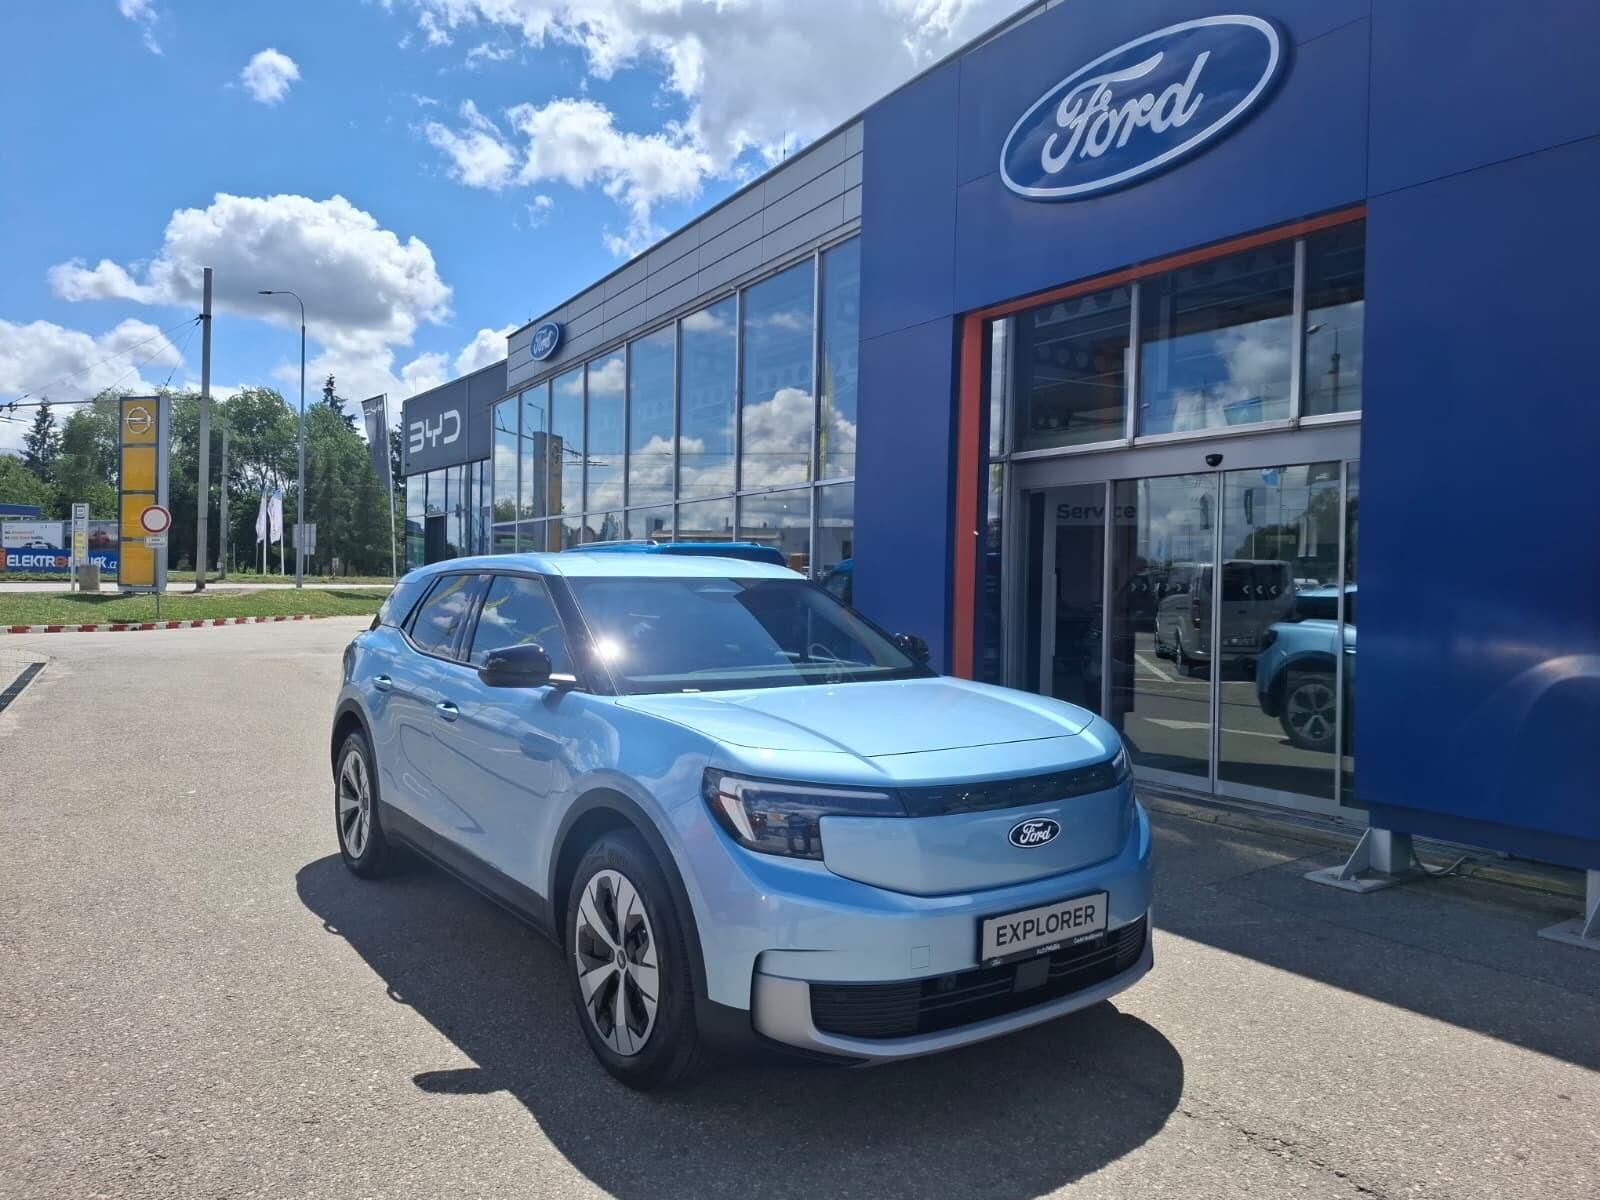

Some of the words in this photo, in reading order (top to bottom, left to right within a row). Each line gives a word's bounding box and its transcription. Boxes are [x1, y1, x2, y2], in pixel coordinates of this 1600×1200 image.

[1041, 50, 1211, 174] Ford
[533, 328, 554, 355] Ford
[409, 409, 461, 454] BYD
[1056, 503, 1136, 519] Servce
[1020, 822, 1052, 844] Ford
[996, 904, 1096, 947] EXPLORER
